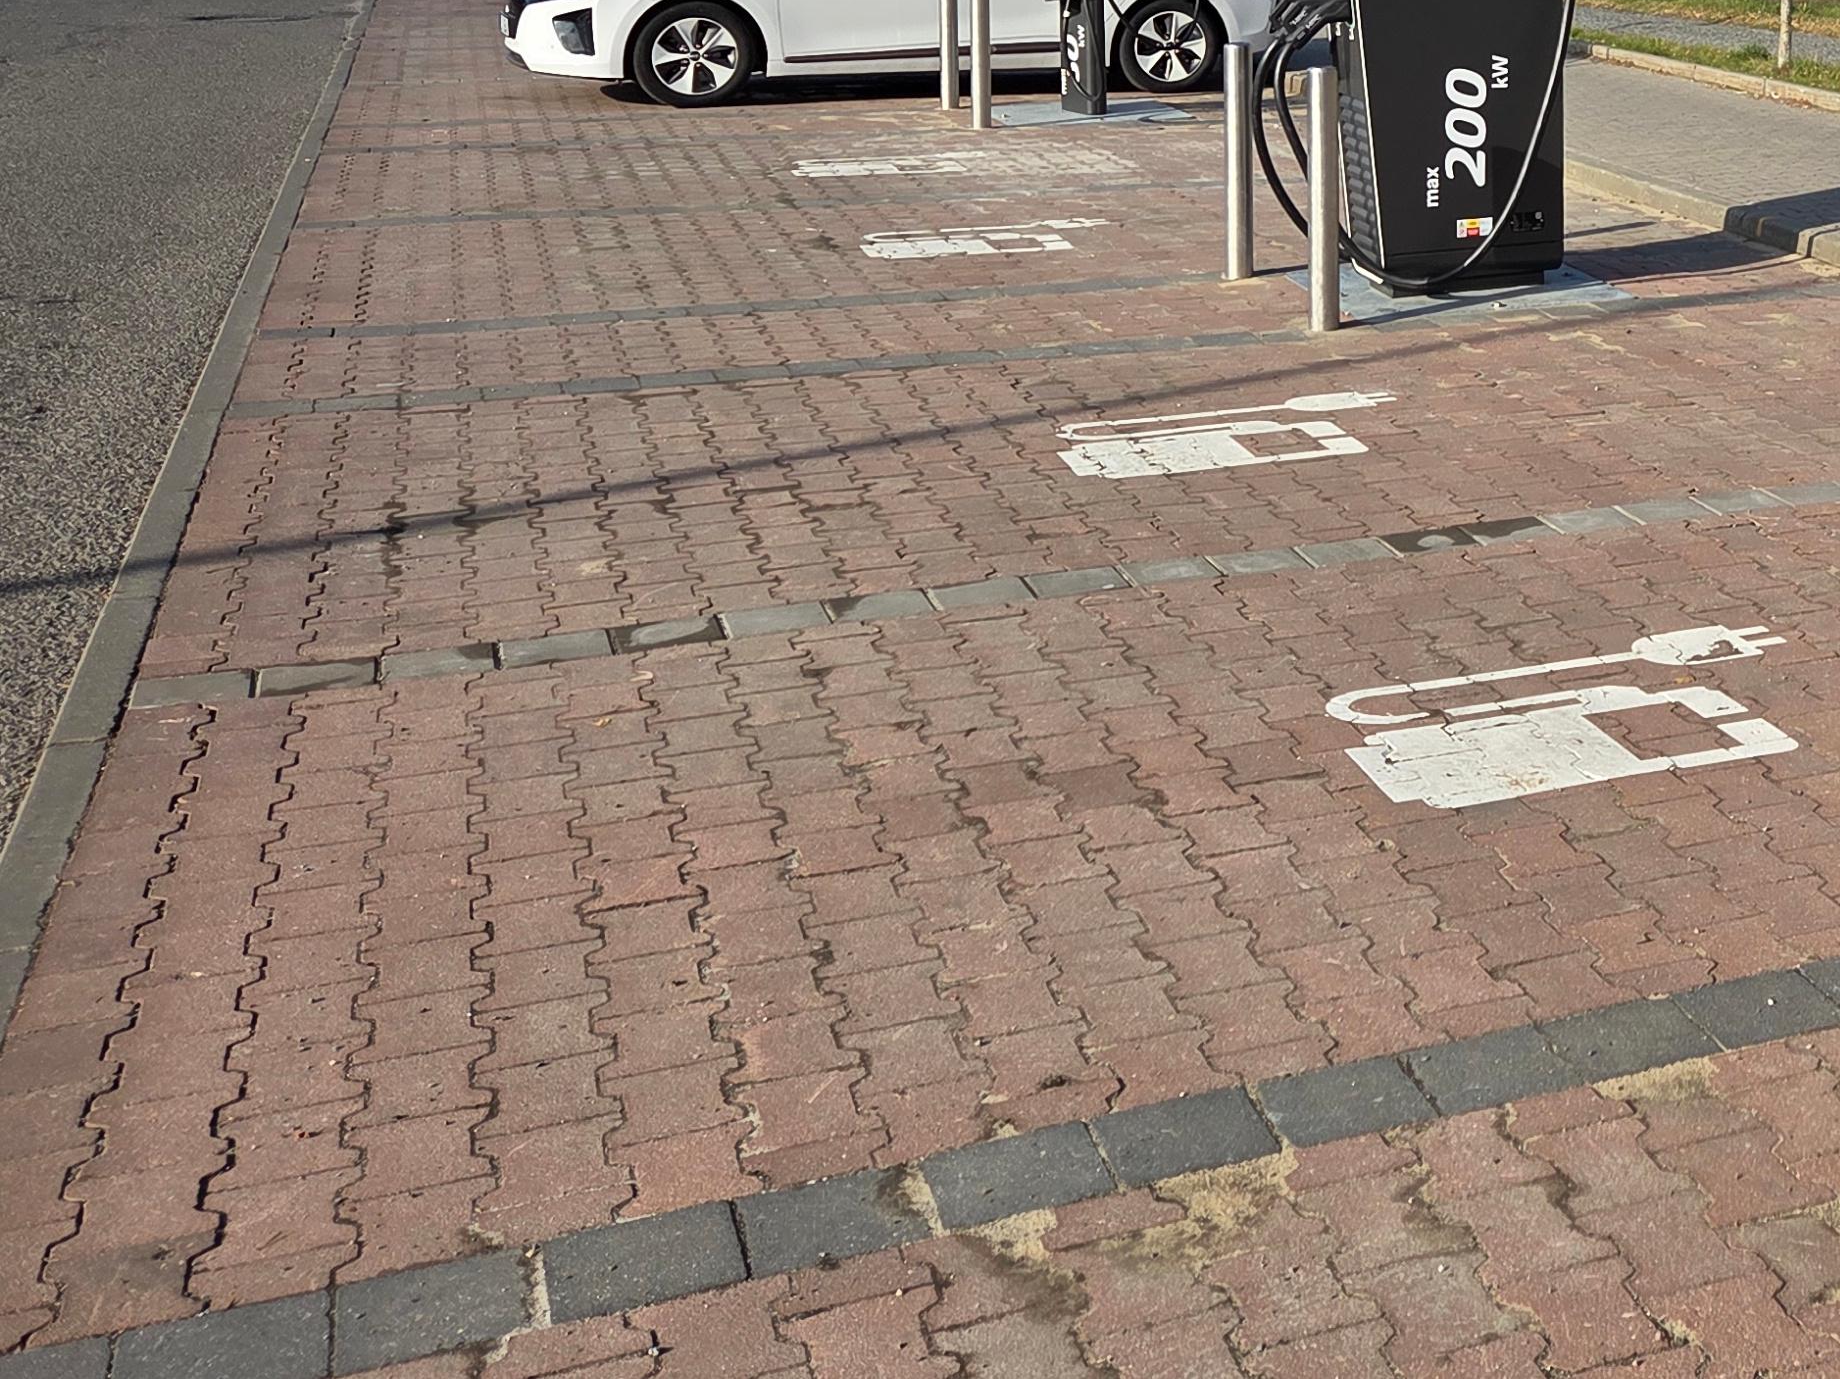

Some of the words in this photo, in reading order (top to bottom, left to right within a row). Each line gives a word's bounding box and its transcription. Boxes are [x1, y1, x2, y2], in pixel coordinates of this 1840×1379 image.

[1426, 166, 1440, 208] max
[1444, 68, 1488, 188] 200
[1491, 54, 1509, 89] kW
